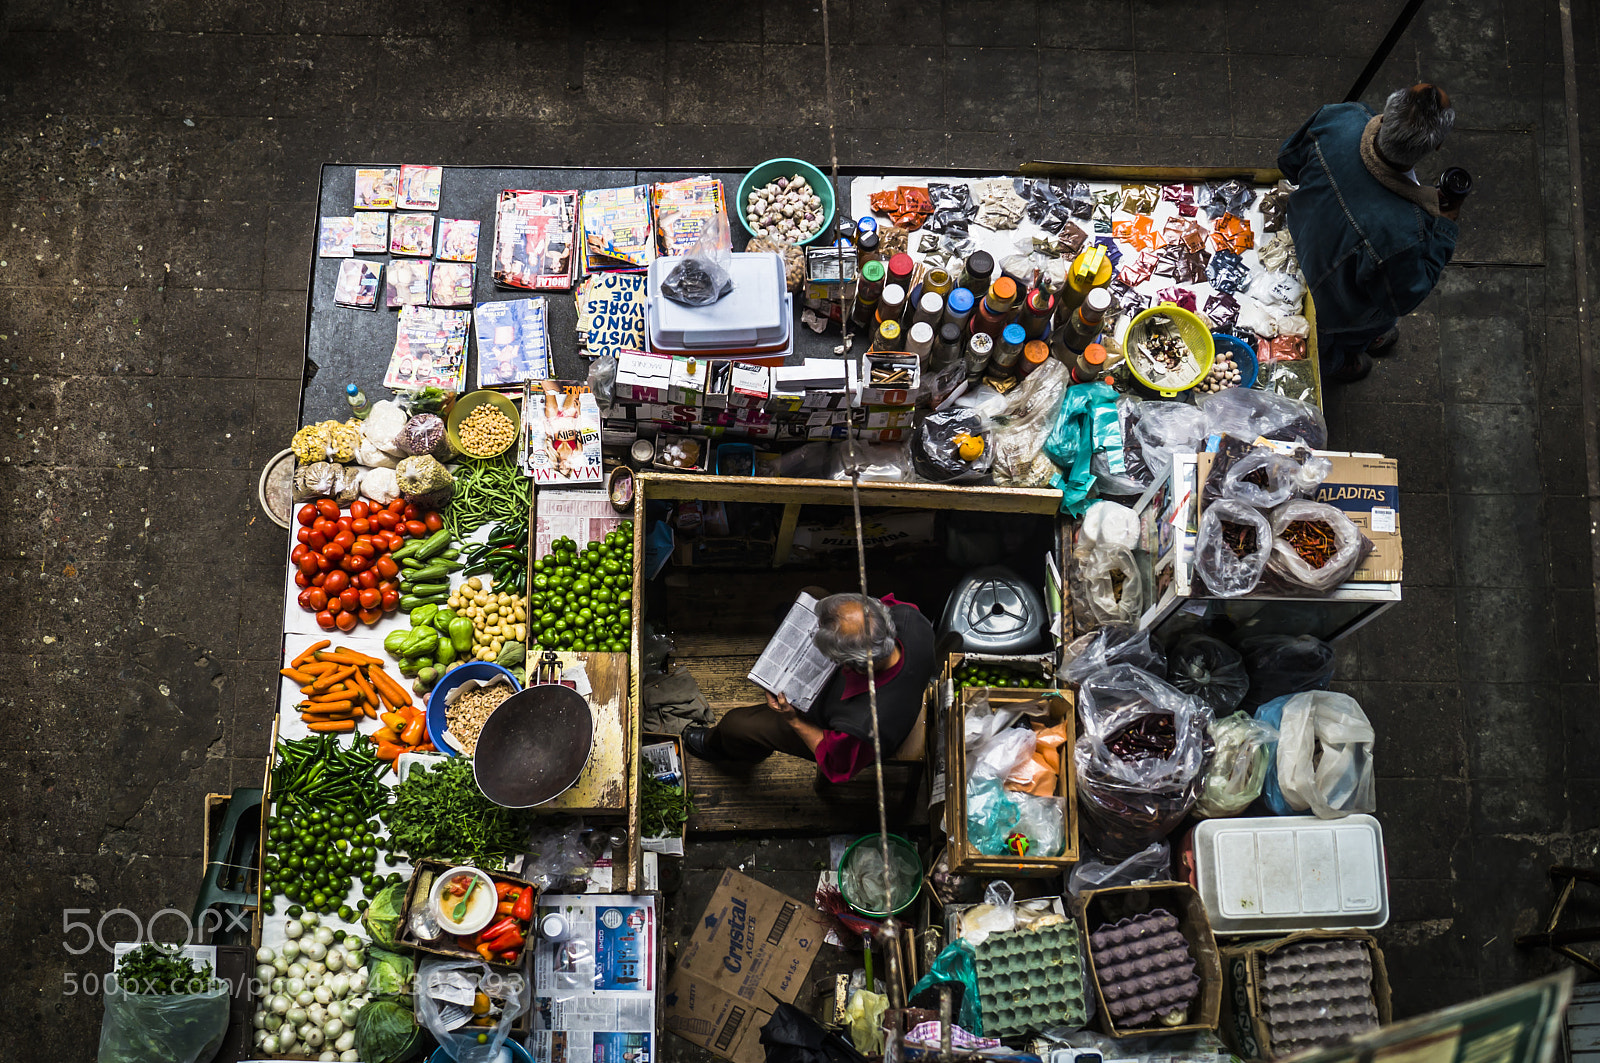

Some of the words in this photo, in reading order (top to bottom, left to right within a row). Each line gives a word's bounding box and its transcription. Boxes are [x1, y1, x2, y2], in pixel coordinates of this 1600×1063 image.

[611, 291, 633, 302] DE
[588, 299, 645, 318] AYORES
[592, 315, 645, 333] ORNO
[587, 330, 646, 351] EVISTA
[536, 465, 600, 481] MAM
[1315, 487, 1386, 502] ALADITAS
[822, 531, 909, 546] POINSTTIA
[722, 896, 747, 974] Cristal
[745, 915, 757, 959] ACEITE
